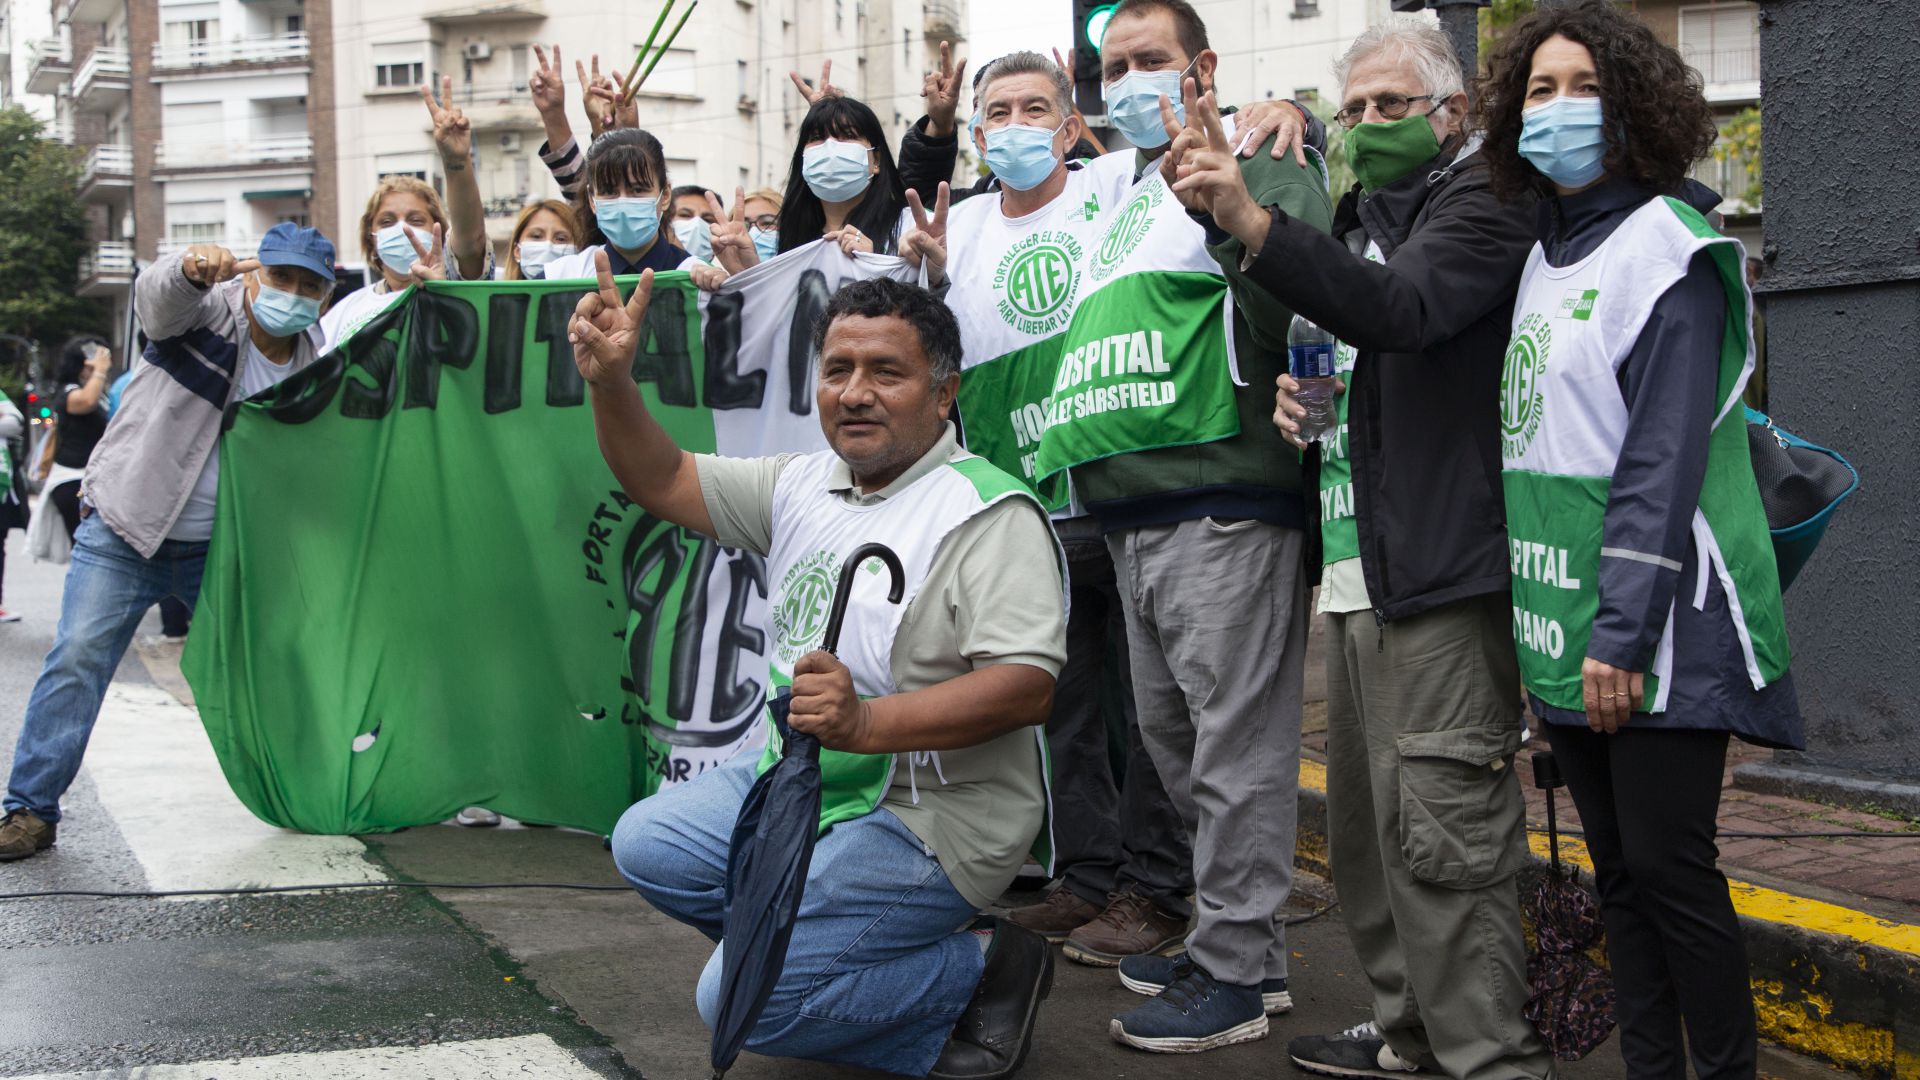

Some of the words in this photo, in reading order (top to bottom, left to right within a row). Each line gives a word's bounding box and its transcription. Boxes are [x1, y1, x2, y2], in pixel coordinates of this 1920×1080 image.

[1041, 231, 1053, 243] EL
[1053, 231, 1084, 262] ESTADO
[1105, 201, 1144, 258] ATE
[1012, 252, 1065, 311] ATE
[997, 299, 1018, 328] PARA
[1017, 317, 1059, 335] LIBERAR
[1059, 310, 1071, 326] LA
[1535, 322, 1553, 375] ESTADO
[1075, 381, 1176, 419] SÁRSFIELD
[1523, 392, 1544, 446] NACION
[1512, 606, 1564, 660] YANO
